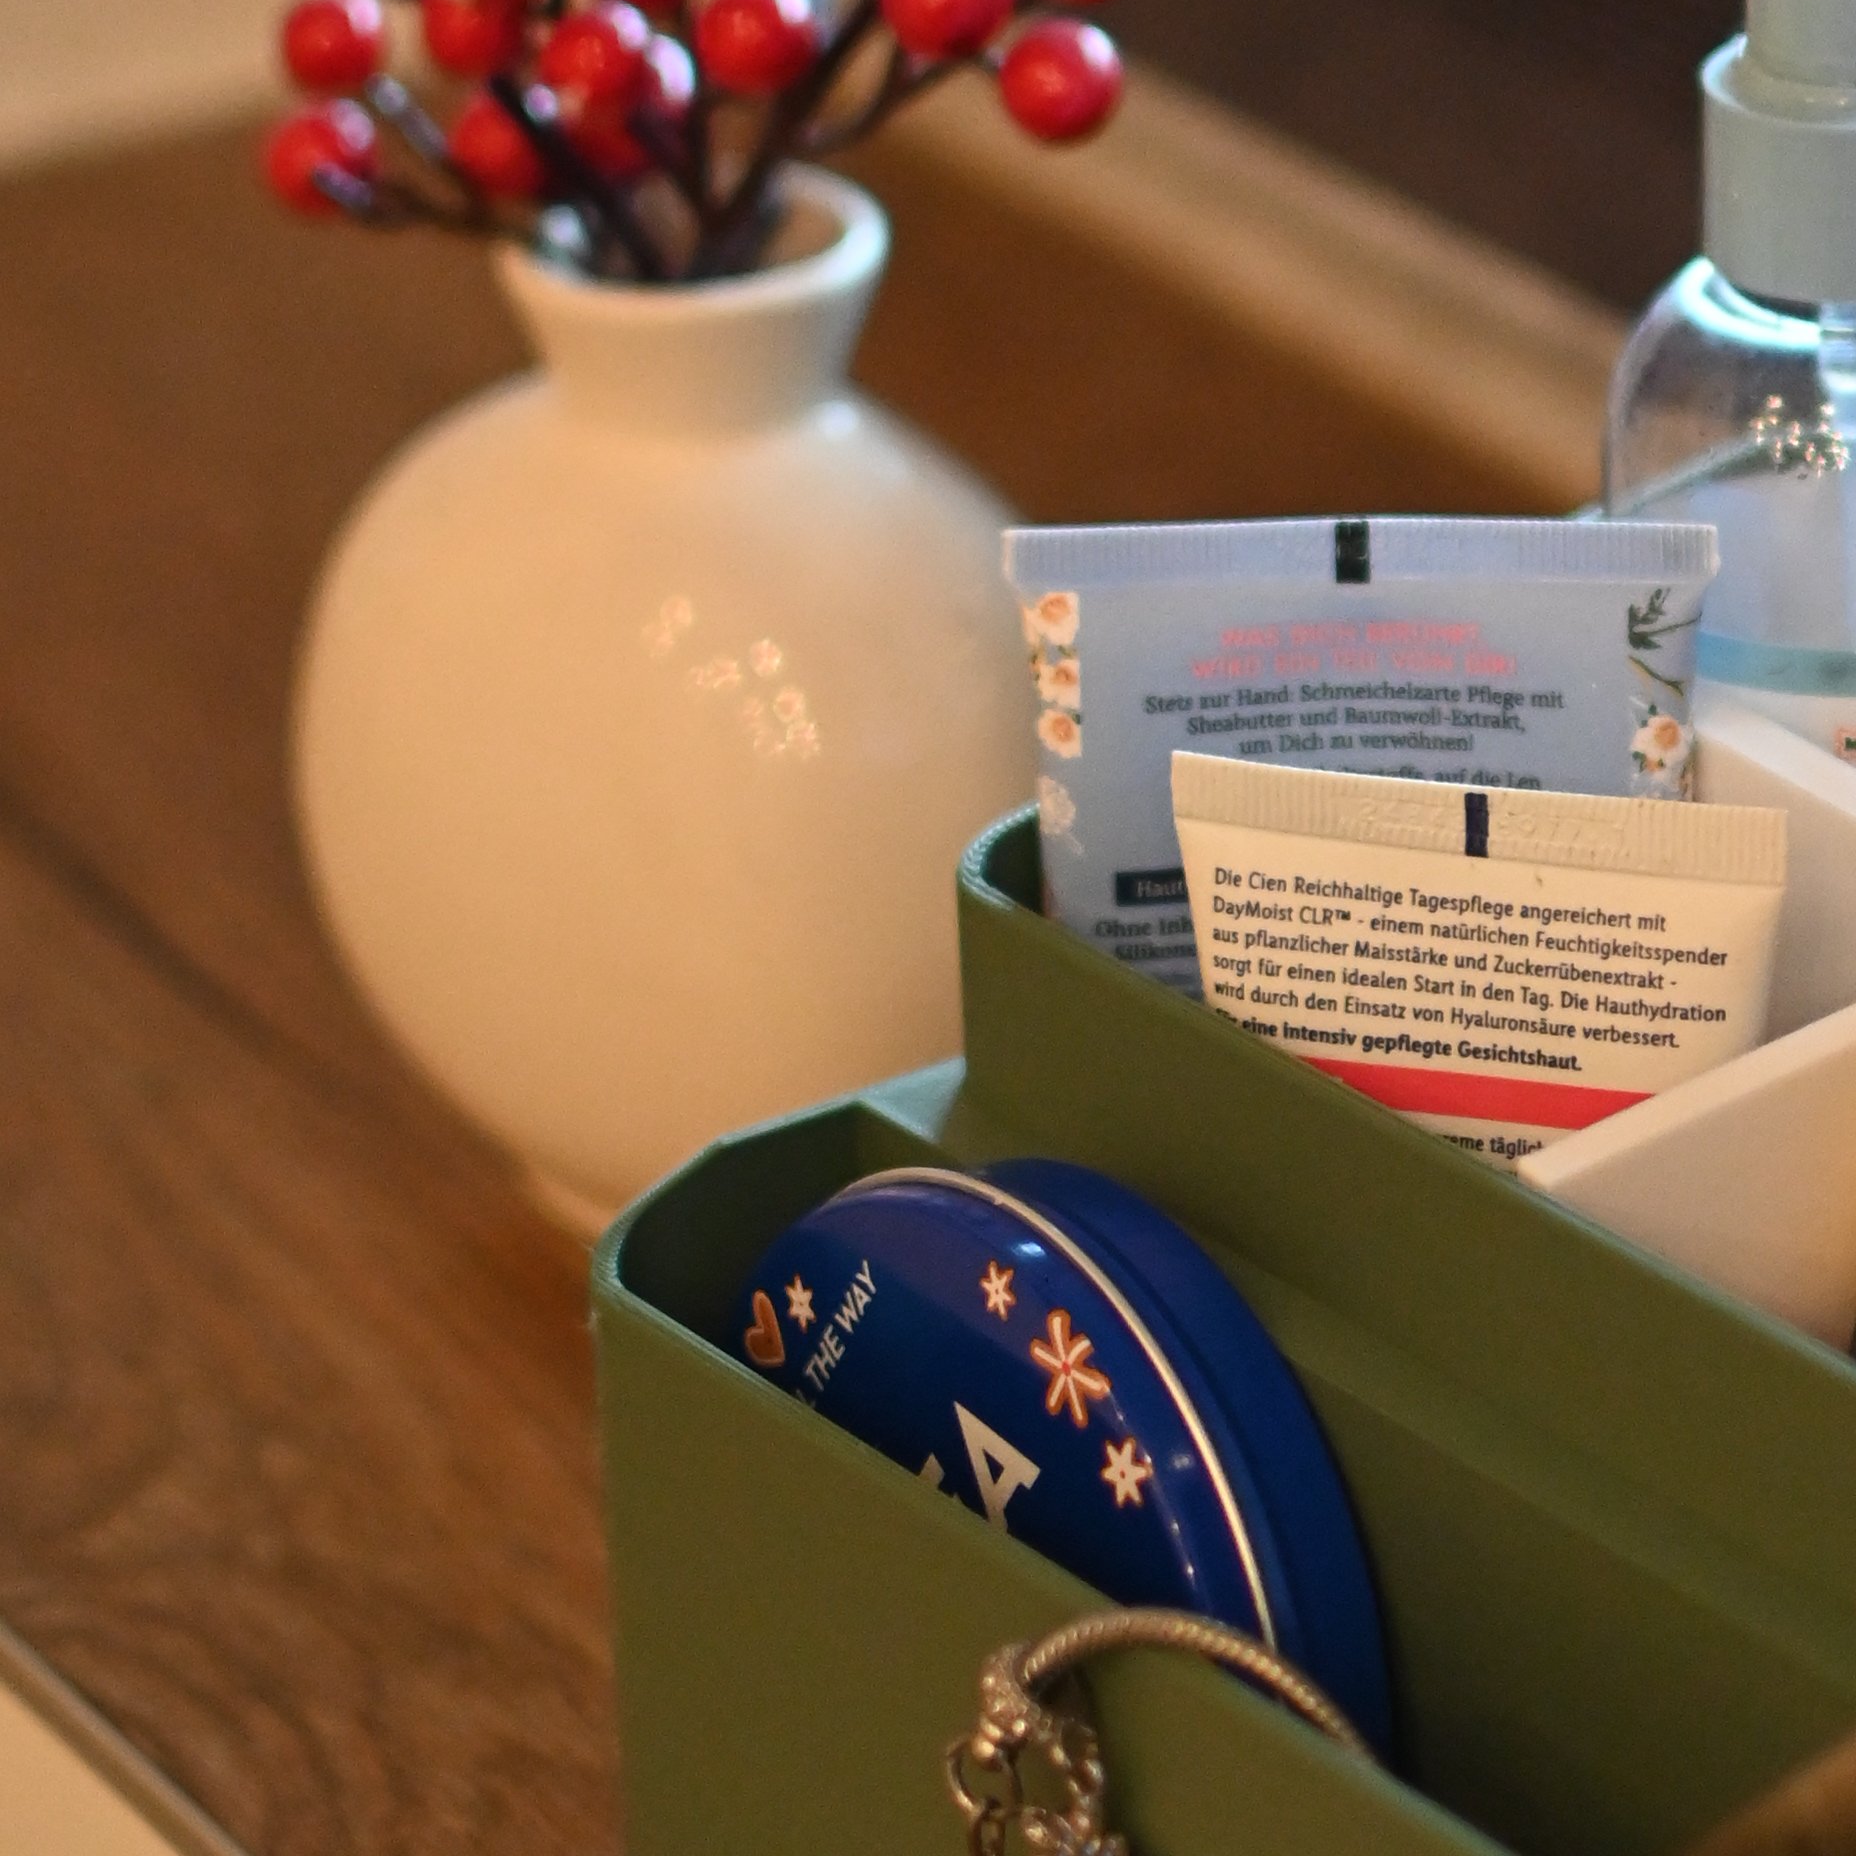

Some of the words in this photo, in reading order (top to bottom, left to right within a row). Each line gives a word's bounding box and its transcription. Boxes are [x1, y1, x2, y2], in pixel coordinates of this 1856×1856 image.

[1144, 694, 1193, 715] Stets
[1199, 693, 1231, 710] zur
[1301, 680, 1462, 703] Schmeichelzarte
[1467, 685, 1525, 710] Pflege
[1531, 690, 1566, 710] mit
[1187, 713, 1294, 736] Sheabutter
[1300, 706, 1338, 727] und
[1344, 705, 1527, 734] Baumwoll-Extrakt,
[1239, 739, 1272, 756] um
[1278, 732, 1324, 753] Dich
[1330, 734, 1353, 750] zu
[1359, 731, 1474, 752] verwöhnen!
[1472, 769, 1501, 787] die
[1214, 866, 1242, 887] Die
[1248, 872, 1287, 892] Cien
[1293, 876, 1404, 908] Reichhaltige
[1410, 887, 1514, 920] Tagespflege
[1520, 904, 1631, 929] angereichert
[1637, 914, 1666, 932] mit
[1213, 895, 1293, 921] DayMoist
[1299, 905, 1351, 926] CLR™
[1370, 916, 1424, 936] einem
[1430, 923, 1529, 947] natürlichen
[1535, 931, 1728, 966] Feuchtigkeitsspender
[1213, 928, 1239, 943] aus
[1244, 929, 1350, 956] pflanzlicher
[1354, 940, 1448, 967] Maisstärke
[1454, 953, 1488, 972] und
[1493, 955, 1665, 990] Zuckerrübenextrakt
[1213, 954, 1252, 977] sorgt
[1258, 958, 1282, 978] für
[1287, 963, 1336, 983] einen
[1342, 967, 1407, 991] idealen
[1413, 974, 1454, 996] Start
[1461, 979, 1477, 998] in
[1482, 982, 1514, 1003] den
[1520, 986, 1554, 1011] Tag.
[1560, 990, 1589, 1011] Die
[1595, 995, 1727, 1022] Hauthydration
[1214, 981, 1245, 1001] wird
[1250, 986, 1298, 1008] durch
[1305, 992, 1338, 1012] den
[1344, 996, 1406, 1020] Einsatz
[1412, 1008, 1444, 1023] von
[1450, 1007, 1576, 1039] Hyaluronsäure
[1582, 1026, 1680, 1049] verbessert.
[1242, 1016, 1278, 1037] eine
[1283, 1021, 1357, 1046] intensiv
[1362, 1033, 1452, 1058] gepflegte
[1457, 1040, 1582, 1072] Gesichtshaut.
[804, 1324, 846, 1391] THE
[834, 1259, 877, 1334] WAY
